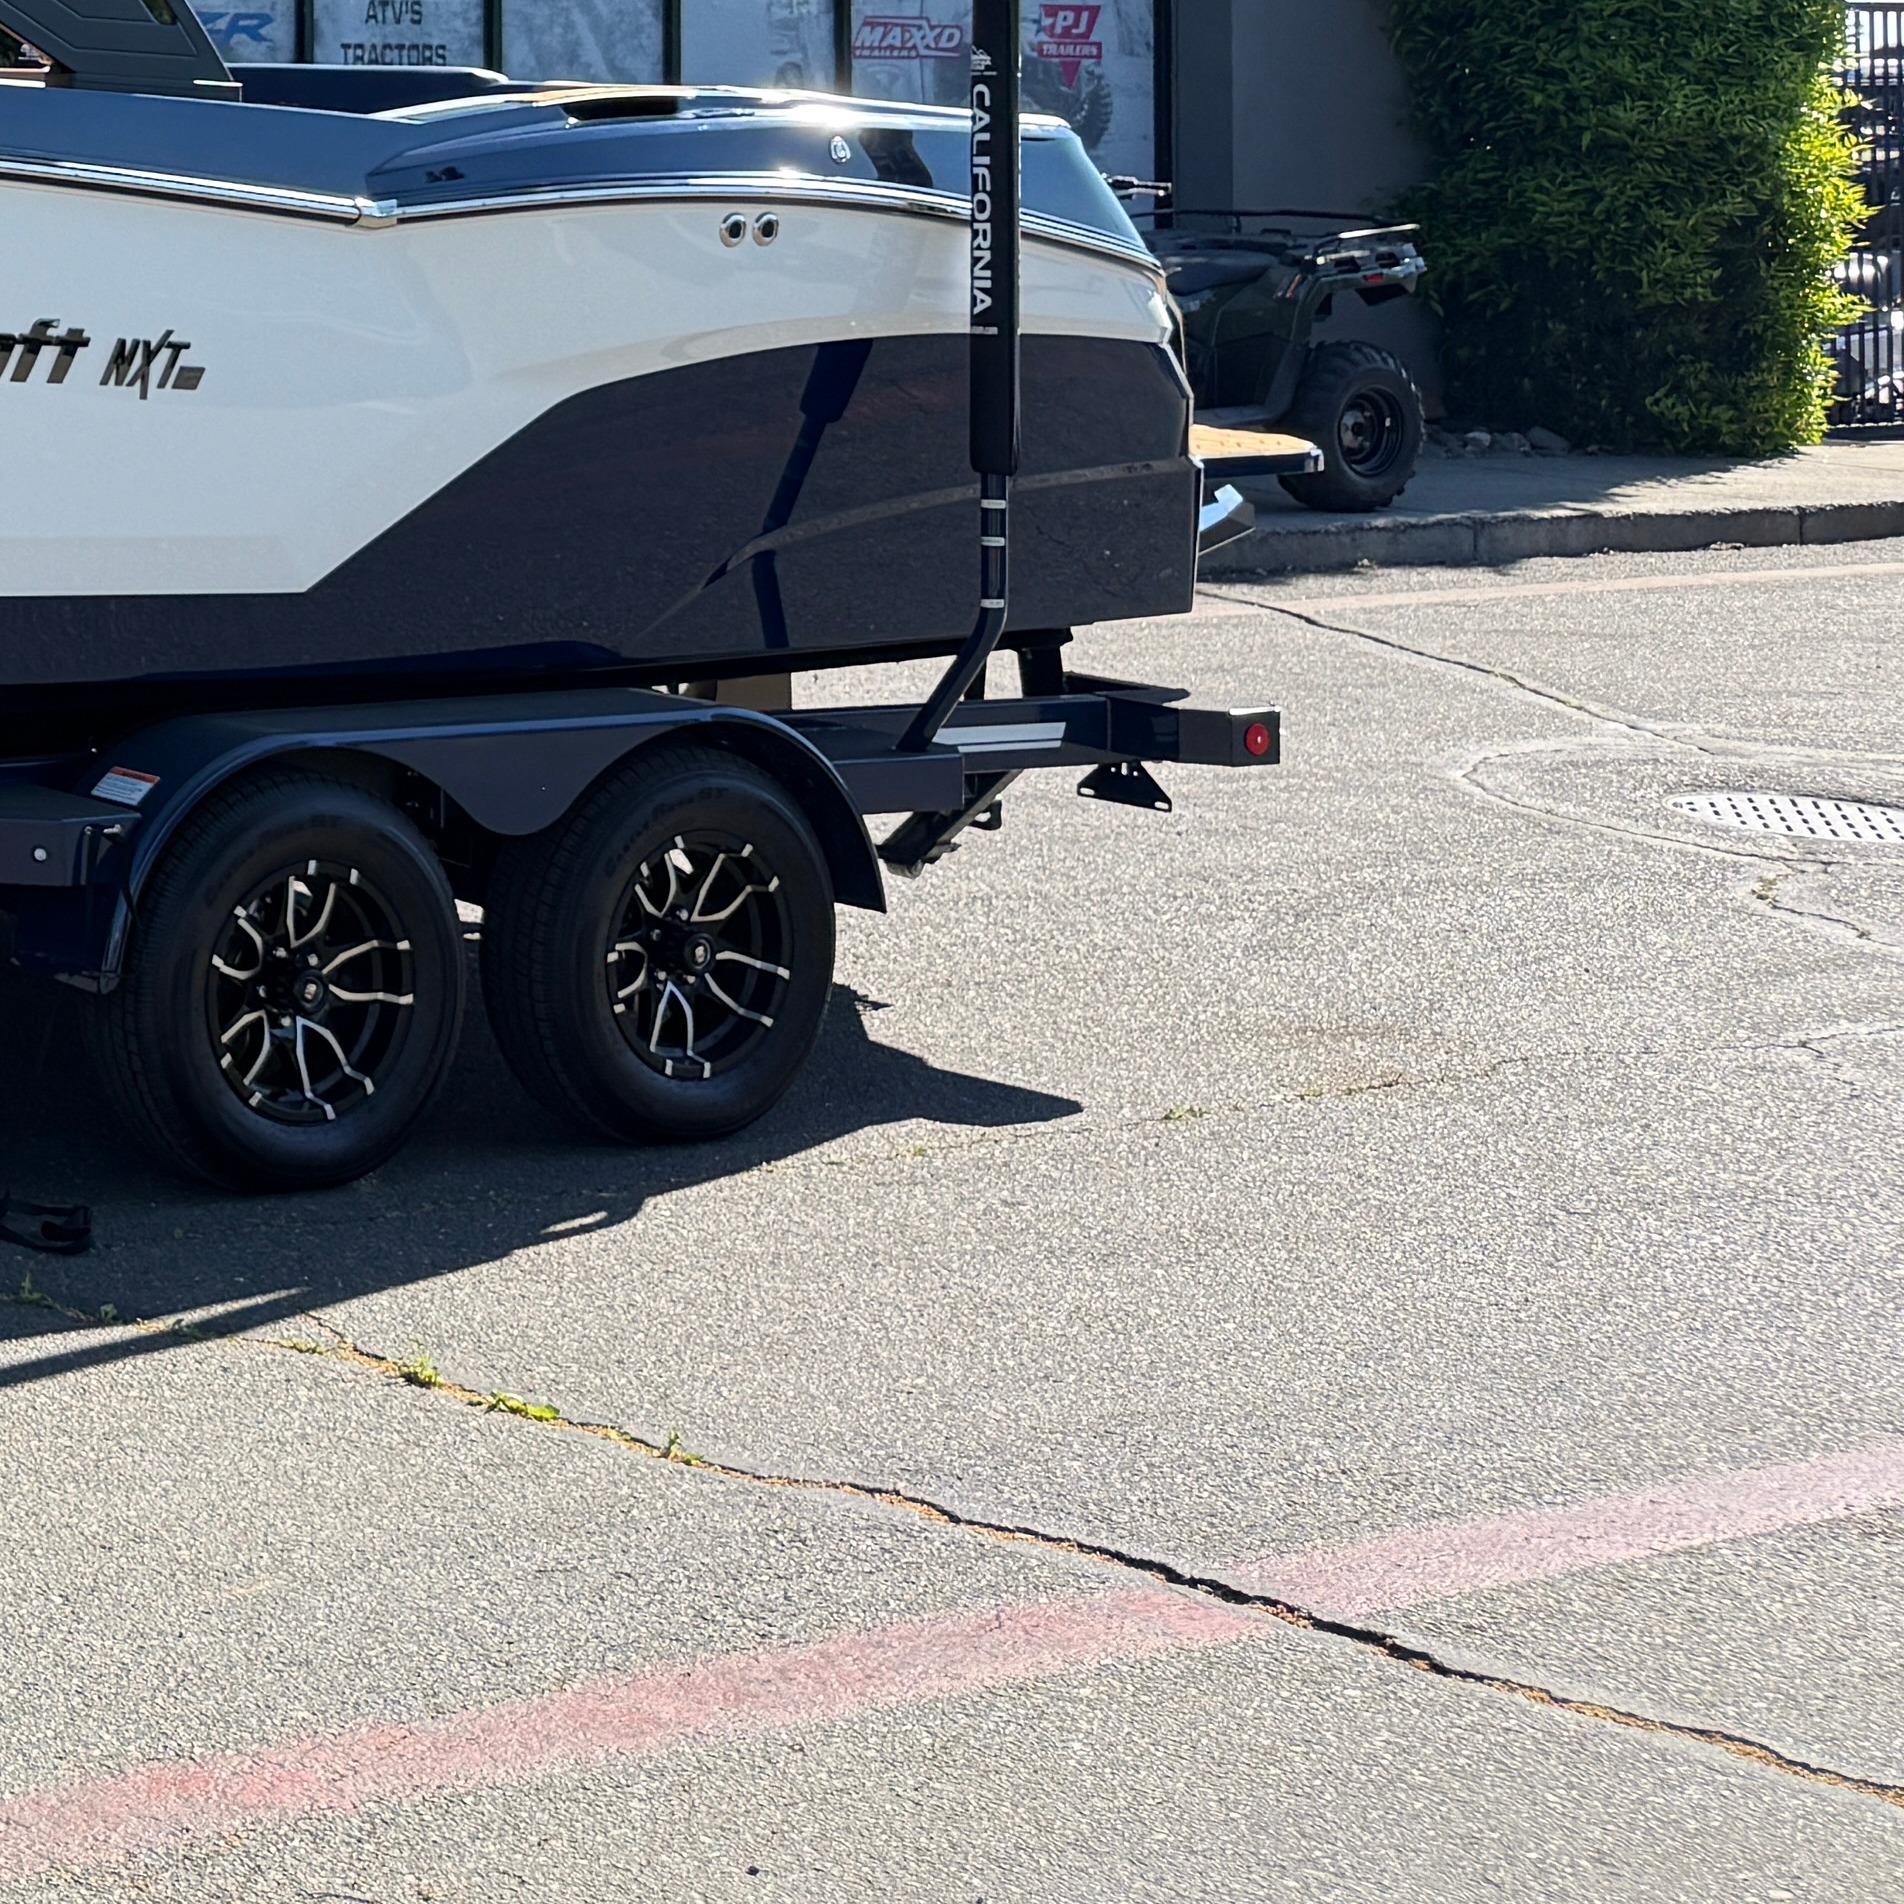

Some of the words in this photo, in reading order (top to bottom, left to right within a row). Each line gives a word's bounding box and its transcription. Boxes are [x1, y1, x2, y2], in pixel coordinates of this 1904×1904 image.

[365, 0, 424, 26] ATV'S
[1054, 9, 1090, 34] PJ
[340, 42, 447, 67] TRACTORS
[1042, 43, 1098, 57] TRAILERS
[971, 83, 992, 317] CALIFORNIA
